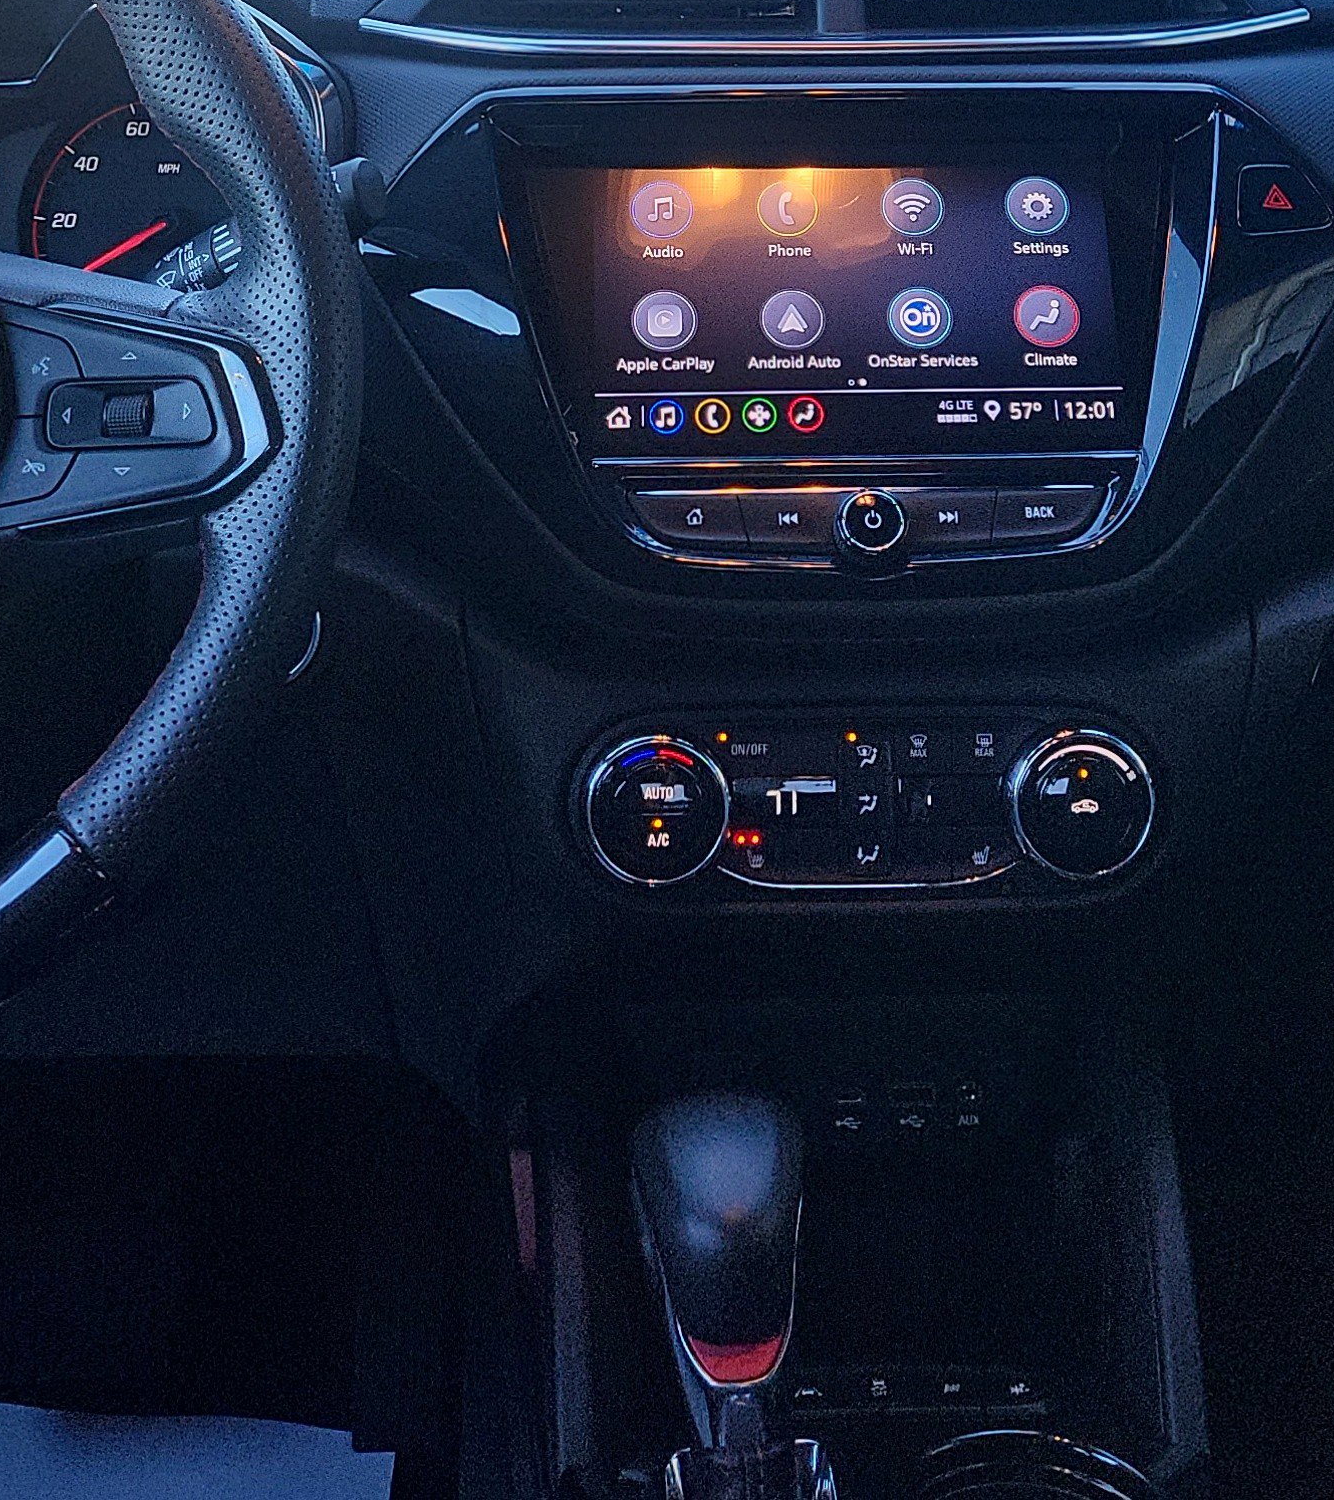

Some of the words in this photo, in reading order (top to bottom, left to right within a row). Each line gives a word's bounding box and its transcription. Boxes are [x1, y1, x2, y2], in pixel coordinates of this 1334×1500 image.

[125, 121, 150, 136] 60
[74, 156, 99, 172] 40
[157, 163, 181, 174] MPH
[51, 213, 77, 228] 20
[642, 245, 684, 259] Audio
[768, 244, 812, 257] Phone
[897, 242, 934, 256] Wi-Fi
[1013, 241, 1070, 257] Settings
[188, 267, 203, 282] OFF
[617, 357, 658, 374] Apple
[661, 356, 715, 374] CarPlay
[748, 355, 804, 370] Android
[807, 356, 841, 370] Auto
[868, 354, 917, 368] OnStar
[920, 353, 979, 367] Services
[1024, 353, 1078, 366] Climate
[939, 400, 954, 410] 4G
[956, 400, 974, 410] LTE
[1064, 401, 1115, 420] 12:01
[1025, 506, 1055, 519] BACK
[731, 743, 768, 756] ON/OFF
[910, 748, 927, 757] MAX
[975, 748, 994, 757] REAR
[644, 786, 674, 800] AUTO
[648, 833, 669, 847] A/C
[957, 1114, 979, 1126] AUX
